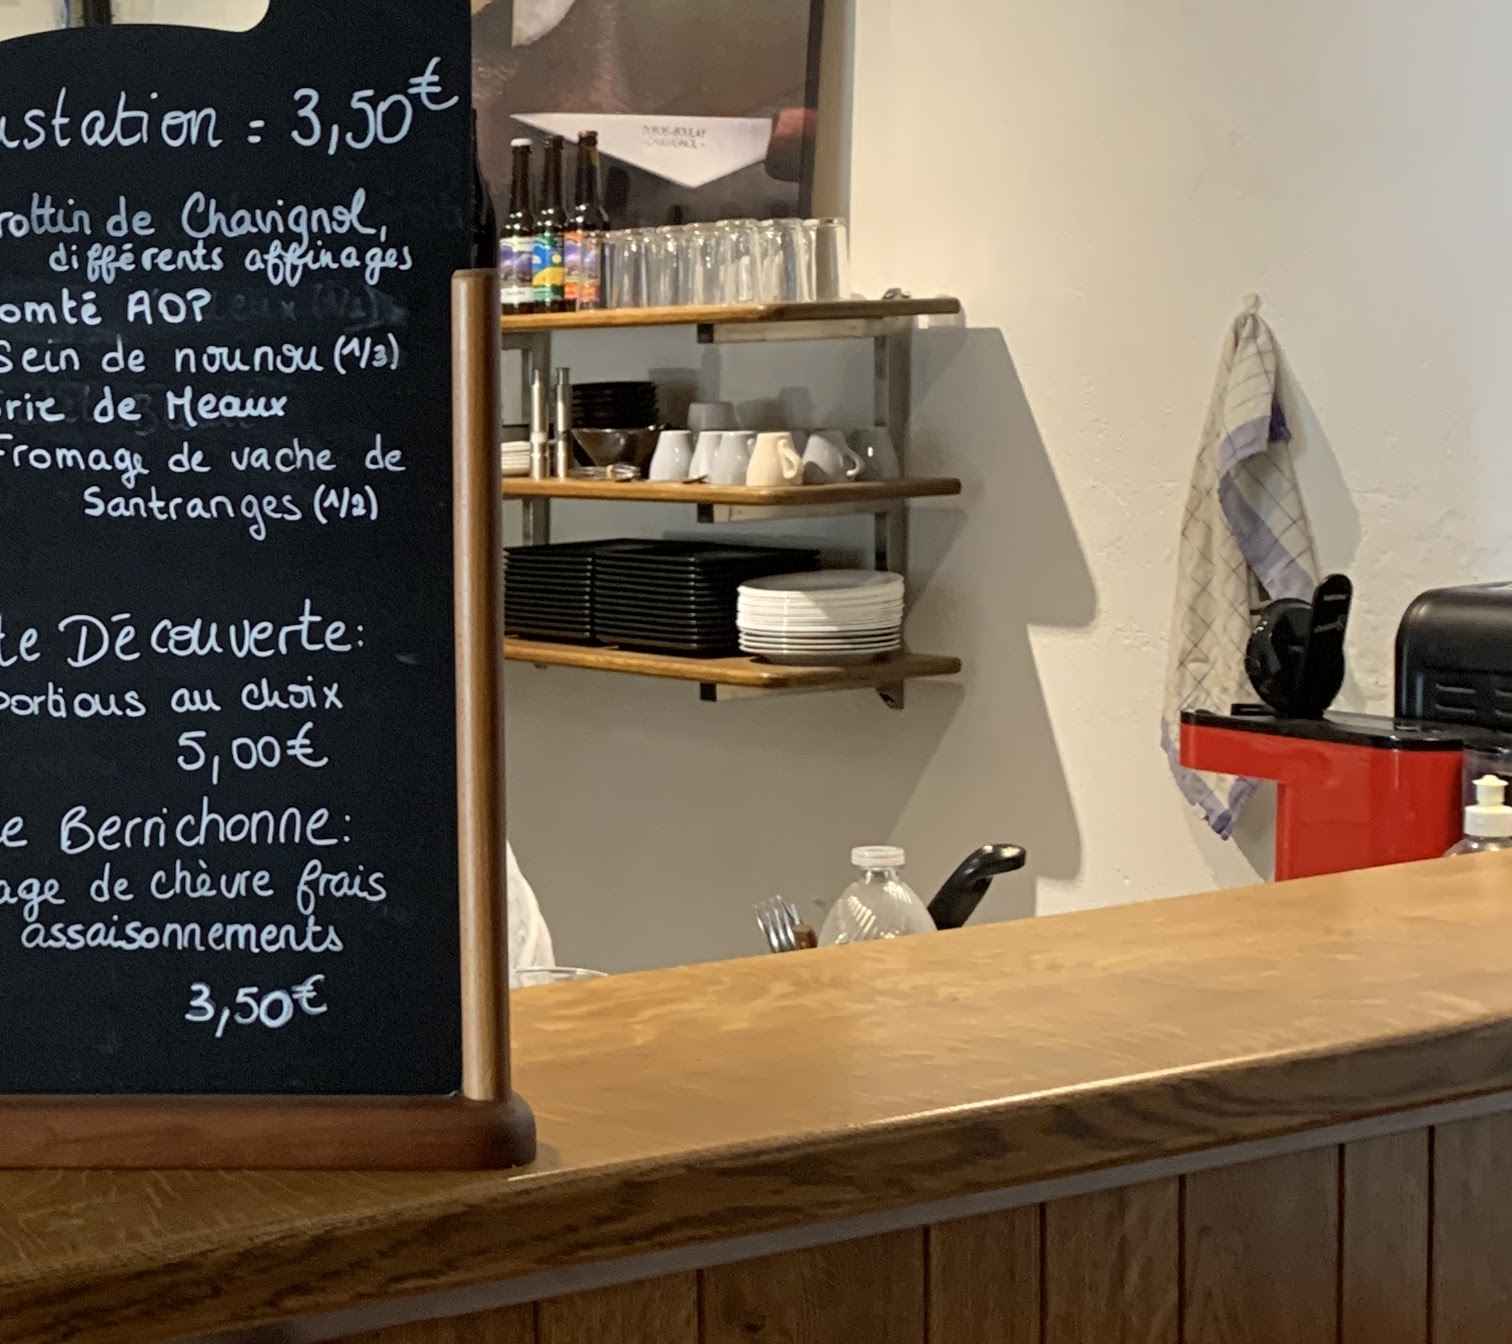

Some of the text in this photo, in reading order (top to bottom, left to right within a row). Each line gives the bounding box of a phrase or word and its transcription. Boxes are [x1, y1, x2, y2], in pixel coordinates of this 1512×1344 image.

[291, 56, 459, 156] 3,50€
[106, 195, 156, 237] de
[49, 239, 413, 285] différents affinages
[127, 288, 212, 325] AOP
[101, 338, 146, 373] de
[175, 343, 324, 374] nounou
[333, 332, 399, 375] (1/3)
[93, 387, 142, 424] de
[166, 385, 288, 423] Meaux
[168, 441, 211, 473] de
[230, 437, 337, 473] vache
[365, 433, 406, 471] de
[83, 481, 378, 541] Santranges (1/2)
[57, 598, 364, 668] Découverte:
[170, 687, 222, 713] au
[241, 675, 343, 711] choix
[177, 721, 329, 785] 5,00€
[60, 795, 351, 855] Berrichonne:
[90, 862, 134, 903] de
[150, 858, 274, 899] chèvre
[296, 859, 387, 916] frais
[21, 912, 343, 954] assaisonnements
[184, 974, 328, 1038] 3,50€
